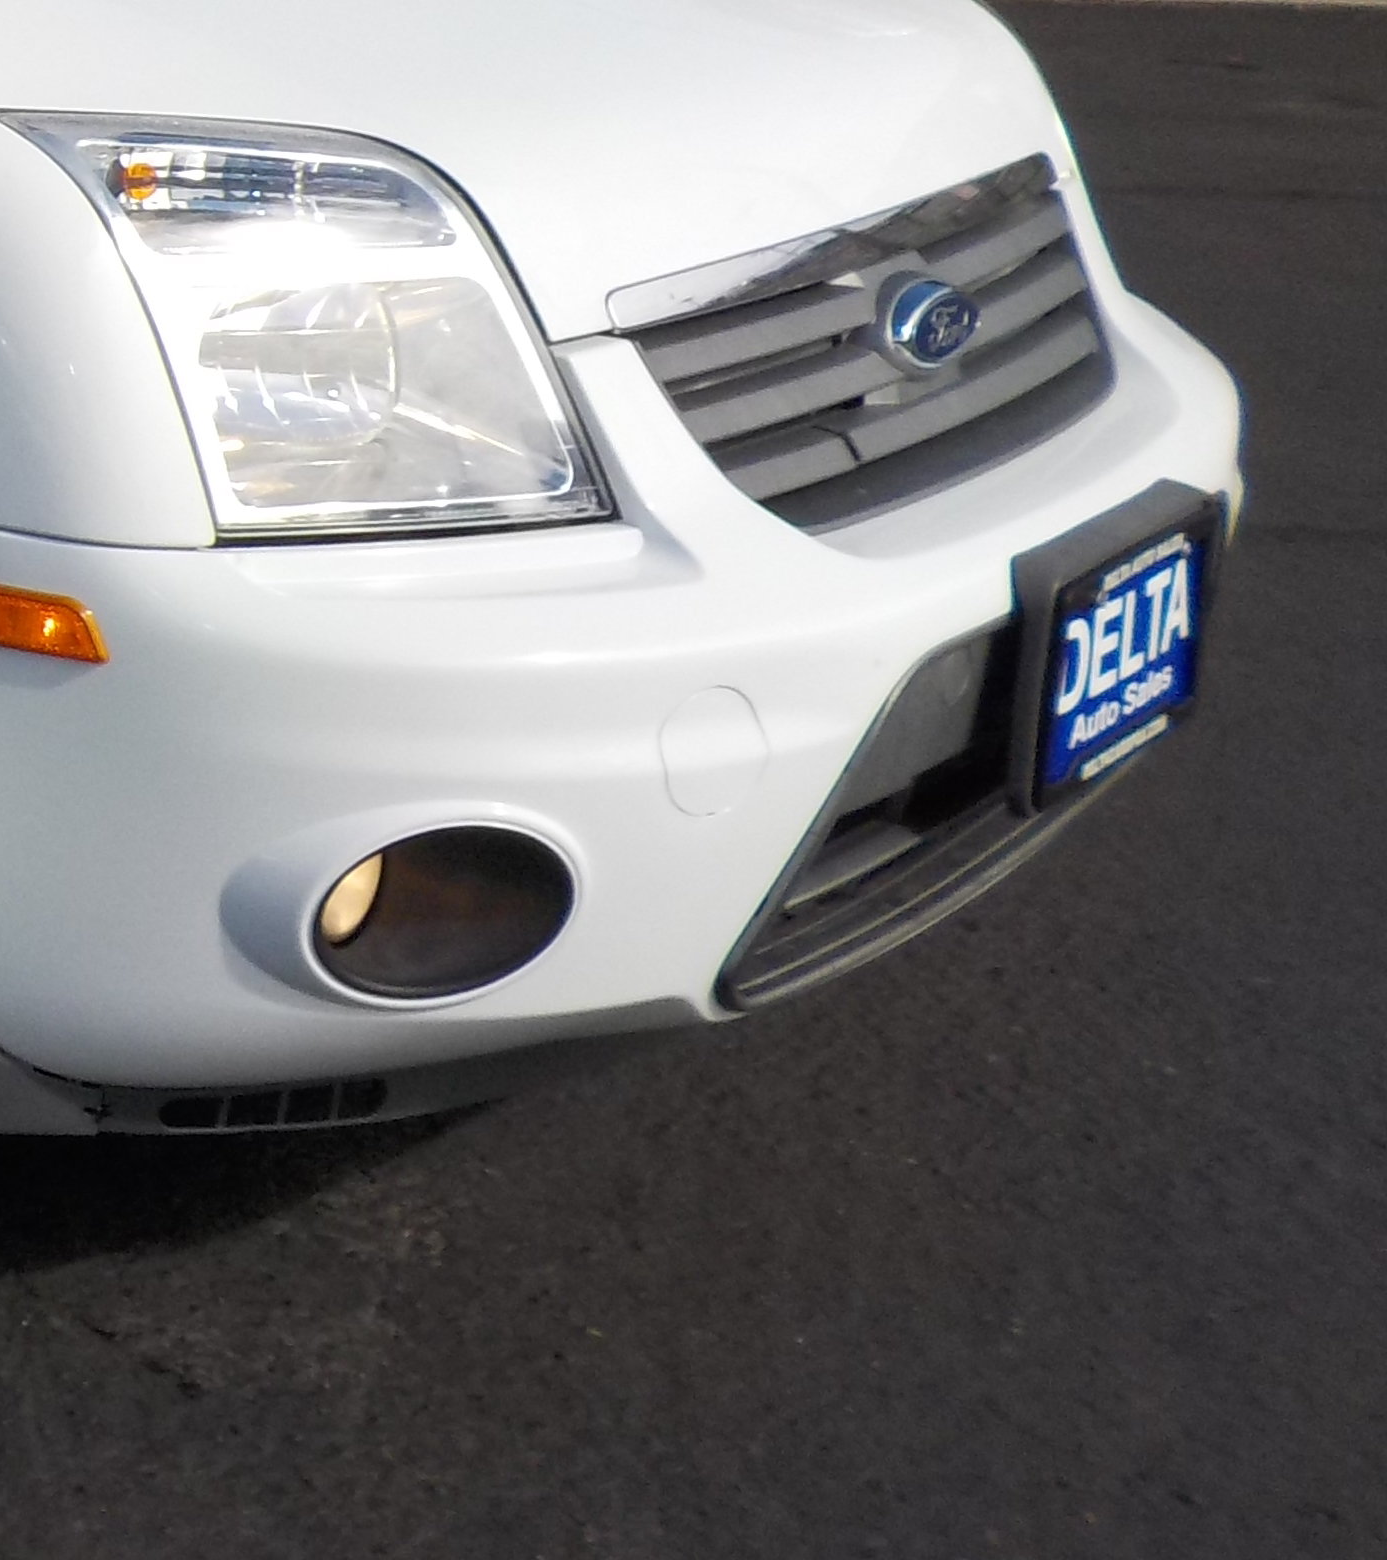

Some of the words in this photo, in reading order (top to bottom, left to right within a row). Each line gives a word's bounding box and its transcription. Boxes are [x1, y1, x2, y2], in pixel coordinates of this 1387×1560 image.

[1055, 557, 1191, 717] DELTA
[1067, 700, 1120, 750] Auto
[1122, 665, 1175, 716] Sales
